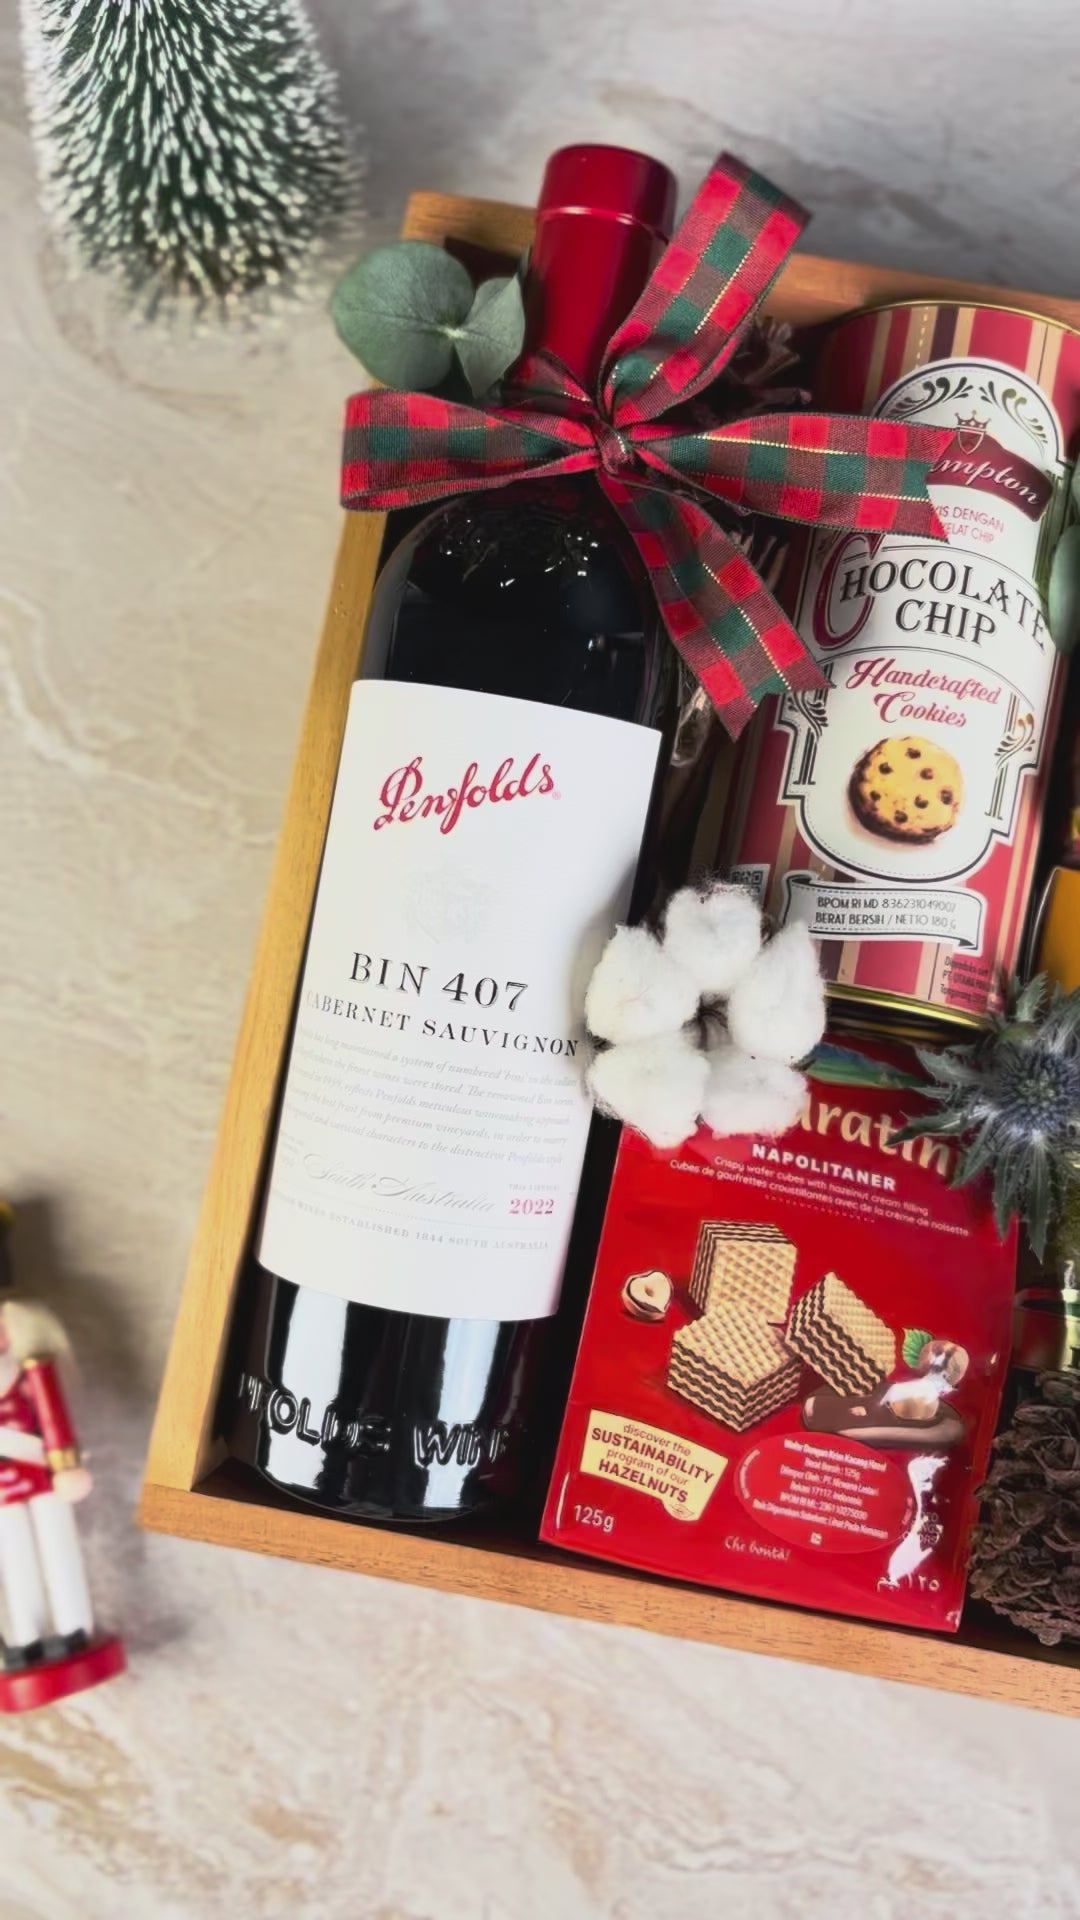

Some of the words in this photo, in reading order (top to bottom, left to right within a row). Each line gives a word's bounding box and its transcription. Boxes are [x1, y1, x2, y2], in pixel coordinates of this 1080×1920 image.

[930, 460, 1040, 504] mpton
[953, 506, 1005, 533] DENGAN
[970, 527, 996, 543] CHIP
[813, 534, 1046, 650] CHOCOLATE
[895, 599, 998, 646] CHIP
[846, 657, 1002, 705] Handcrafted
[873, 691, 968, 728] Cookies
[373, 753, 554, 835] Penfolds
[815, 912, 846, 924] BERAT
[848, 914, 885, 925] BERSIH
[895, 914, 929, 926] NETTO
[817, 897, 849, 909] BPOM
[851, 898, 861, 908] RI
[863, 898, 879, 908] MD
[349, 951, 430, 997] BIN
[442, 971, 529, 1013] 407
[306, 990, 411, 1031] CABERNET
[422, 1019, 579, 1057] SAUVIGNON
[448, 1065, 502, 1080] numbered
[383, 1112, 433, 1131] premium
[714, 1155, 745, 1173] Crispy
[747, 1164, 775, 1178] wafer
[776, 1170, 805, 1185] cubes
[808, 1177, 827, 1190] with
[829, 1181, 869, 1201] hazelnut
[871, 1193, 901, 1209] cream
[903, 1200, 929, 1217] filling
[752, 1143, 896, 1191] NAPOLITANER
[508, 1197, 556, 1216] 2022
[669, 1159, 700, 1174] Cubes
[702, 1165, 715, 1177] de
[716, 1170, 767, 1189] gaufrettes
[834, 1197, 858, 1210] avec
[859, 1202, 873, 1213] de
[917, 1216, 930, 1228] de
[931, 1220, 969, 1237] noisette
[328, 1211, 411, 1239] ESTABLISHED
[415, 1231, 445, 1243] 1844
[591, 1427, 715, 1484] SUSTAINABILITY
[623, 1423, 671, 1448] discover
[673, 1442, 691, 1457] the
[598, 1458, 689, 1504] HAZELNUTS
[606, 1449, 654, 1472] program
[656, 1466, 669, 1477] of
[670, 1473, 690, 1486] our
[573, 1504, 615, 1534] 125g
